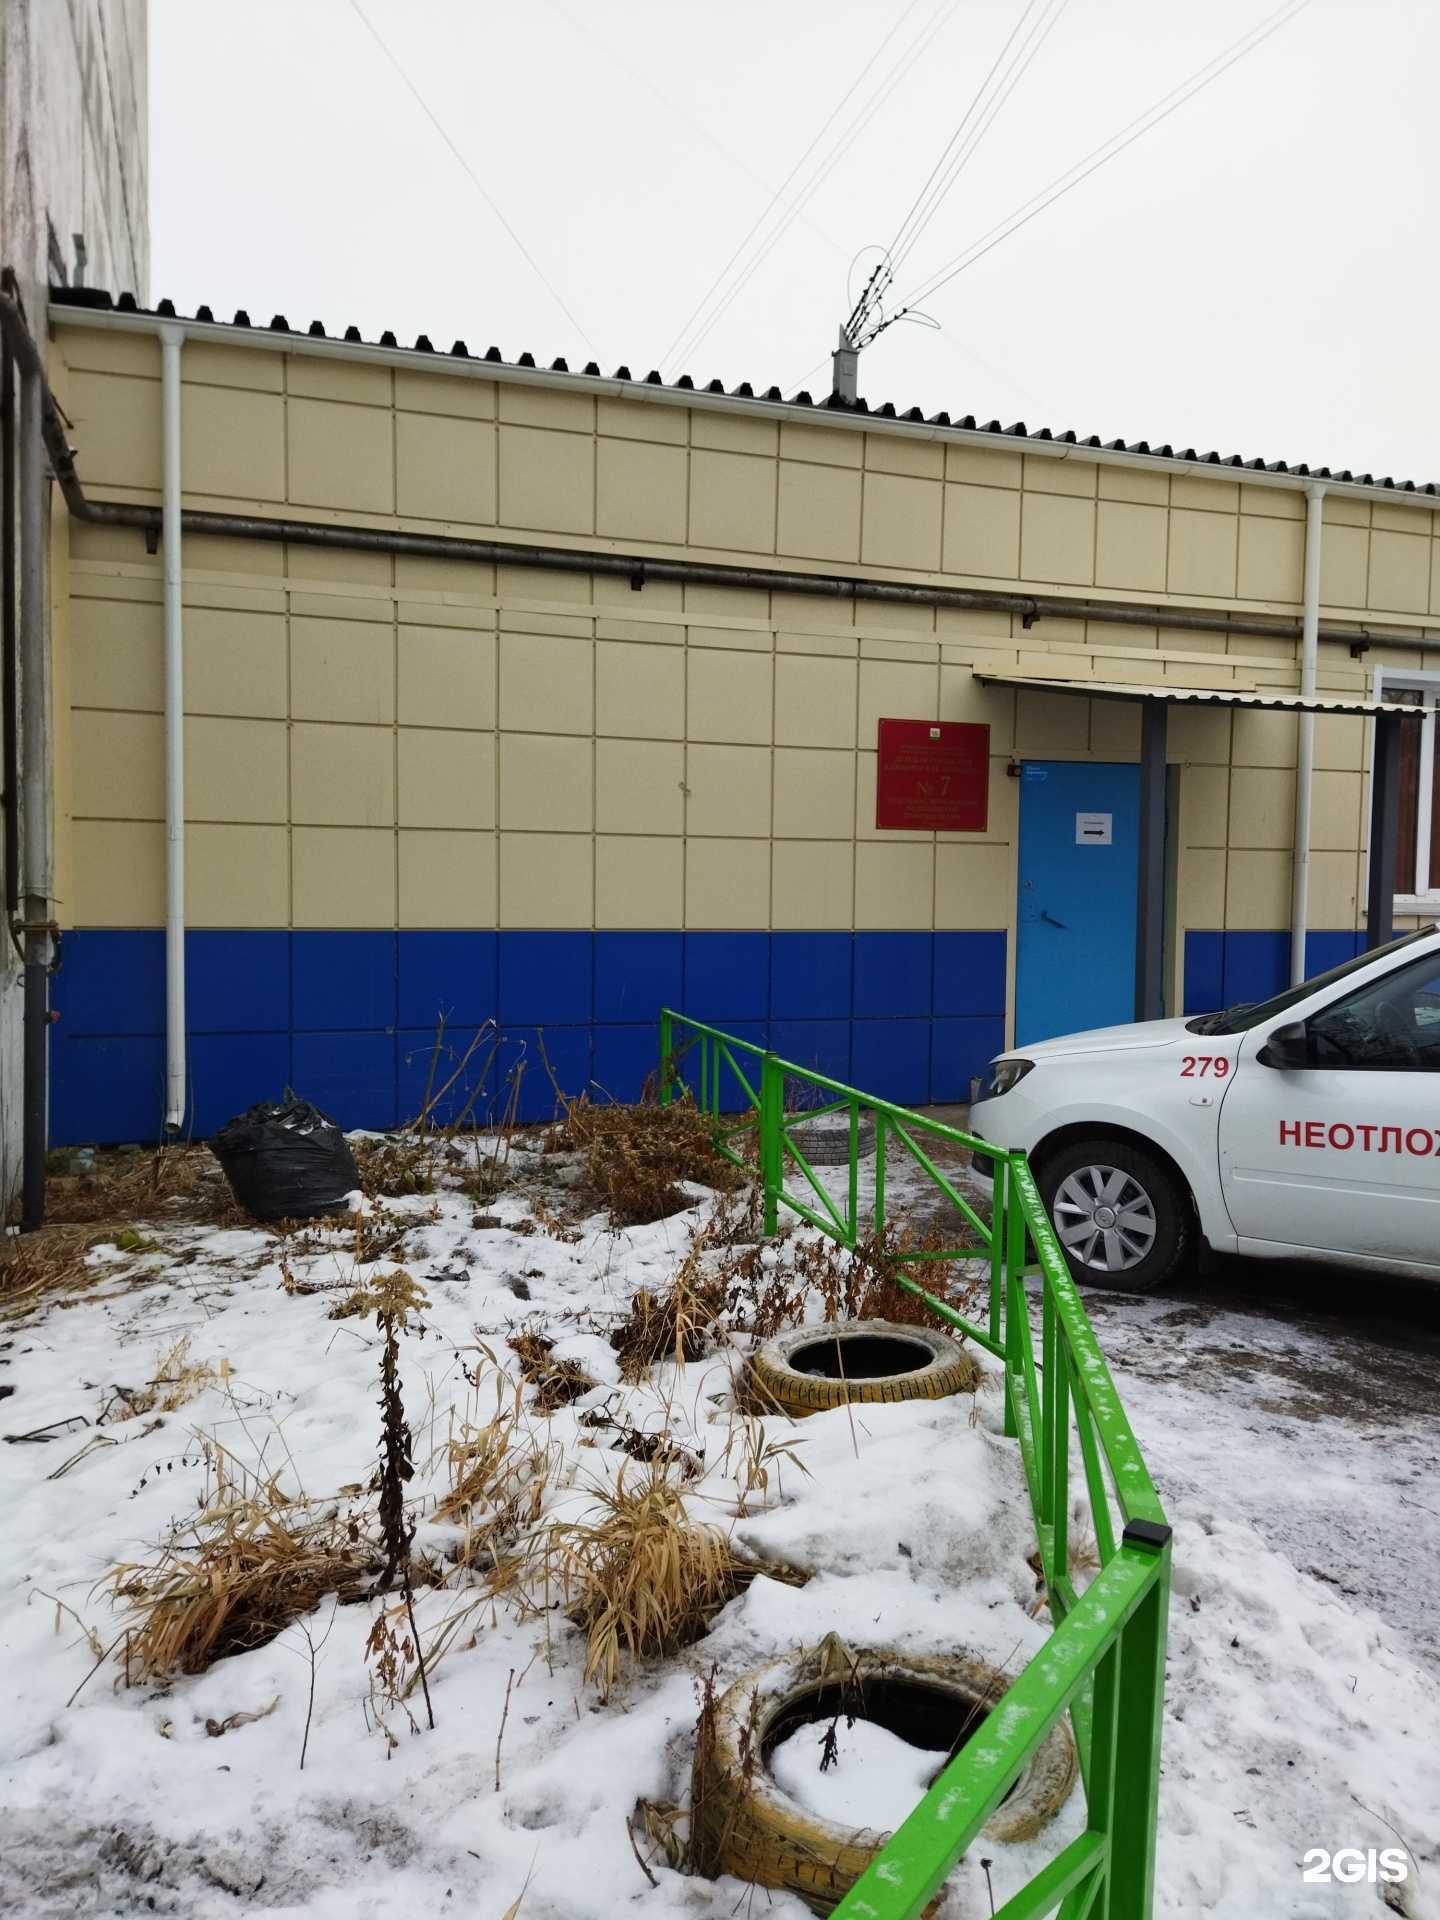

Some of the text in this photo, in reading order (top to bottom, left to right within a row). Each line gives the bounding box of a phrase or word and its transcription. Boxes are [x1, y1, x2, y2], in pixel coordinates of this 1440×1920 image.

[939, 775, 952, 796] 7
[1180, 1056, 1230, 1078] 279
[1279, 1119, 1440, 1157] НЕОТЛО
